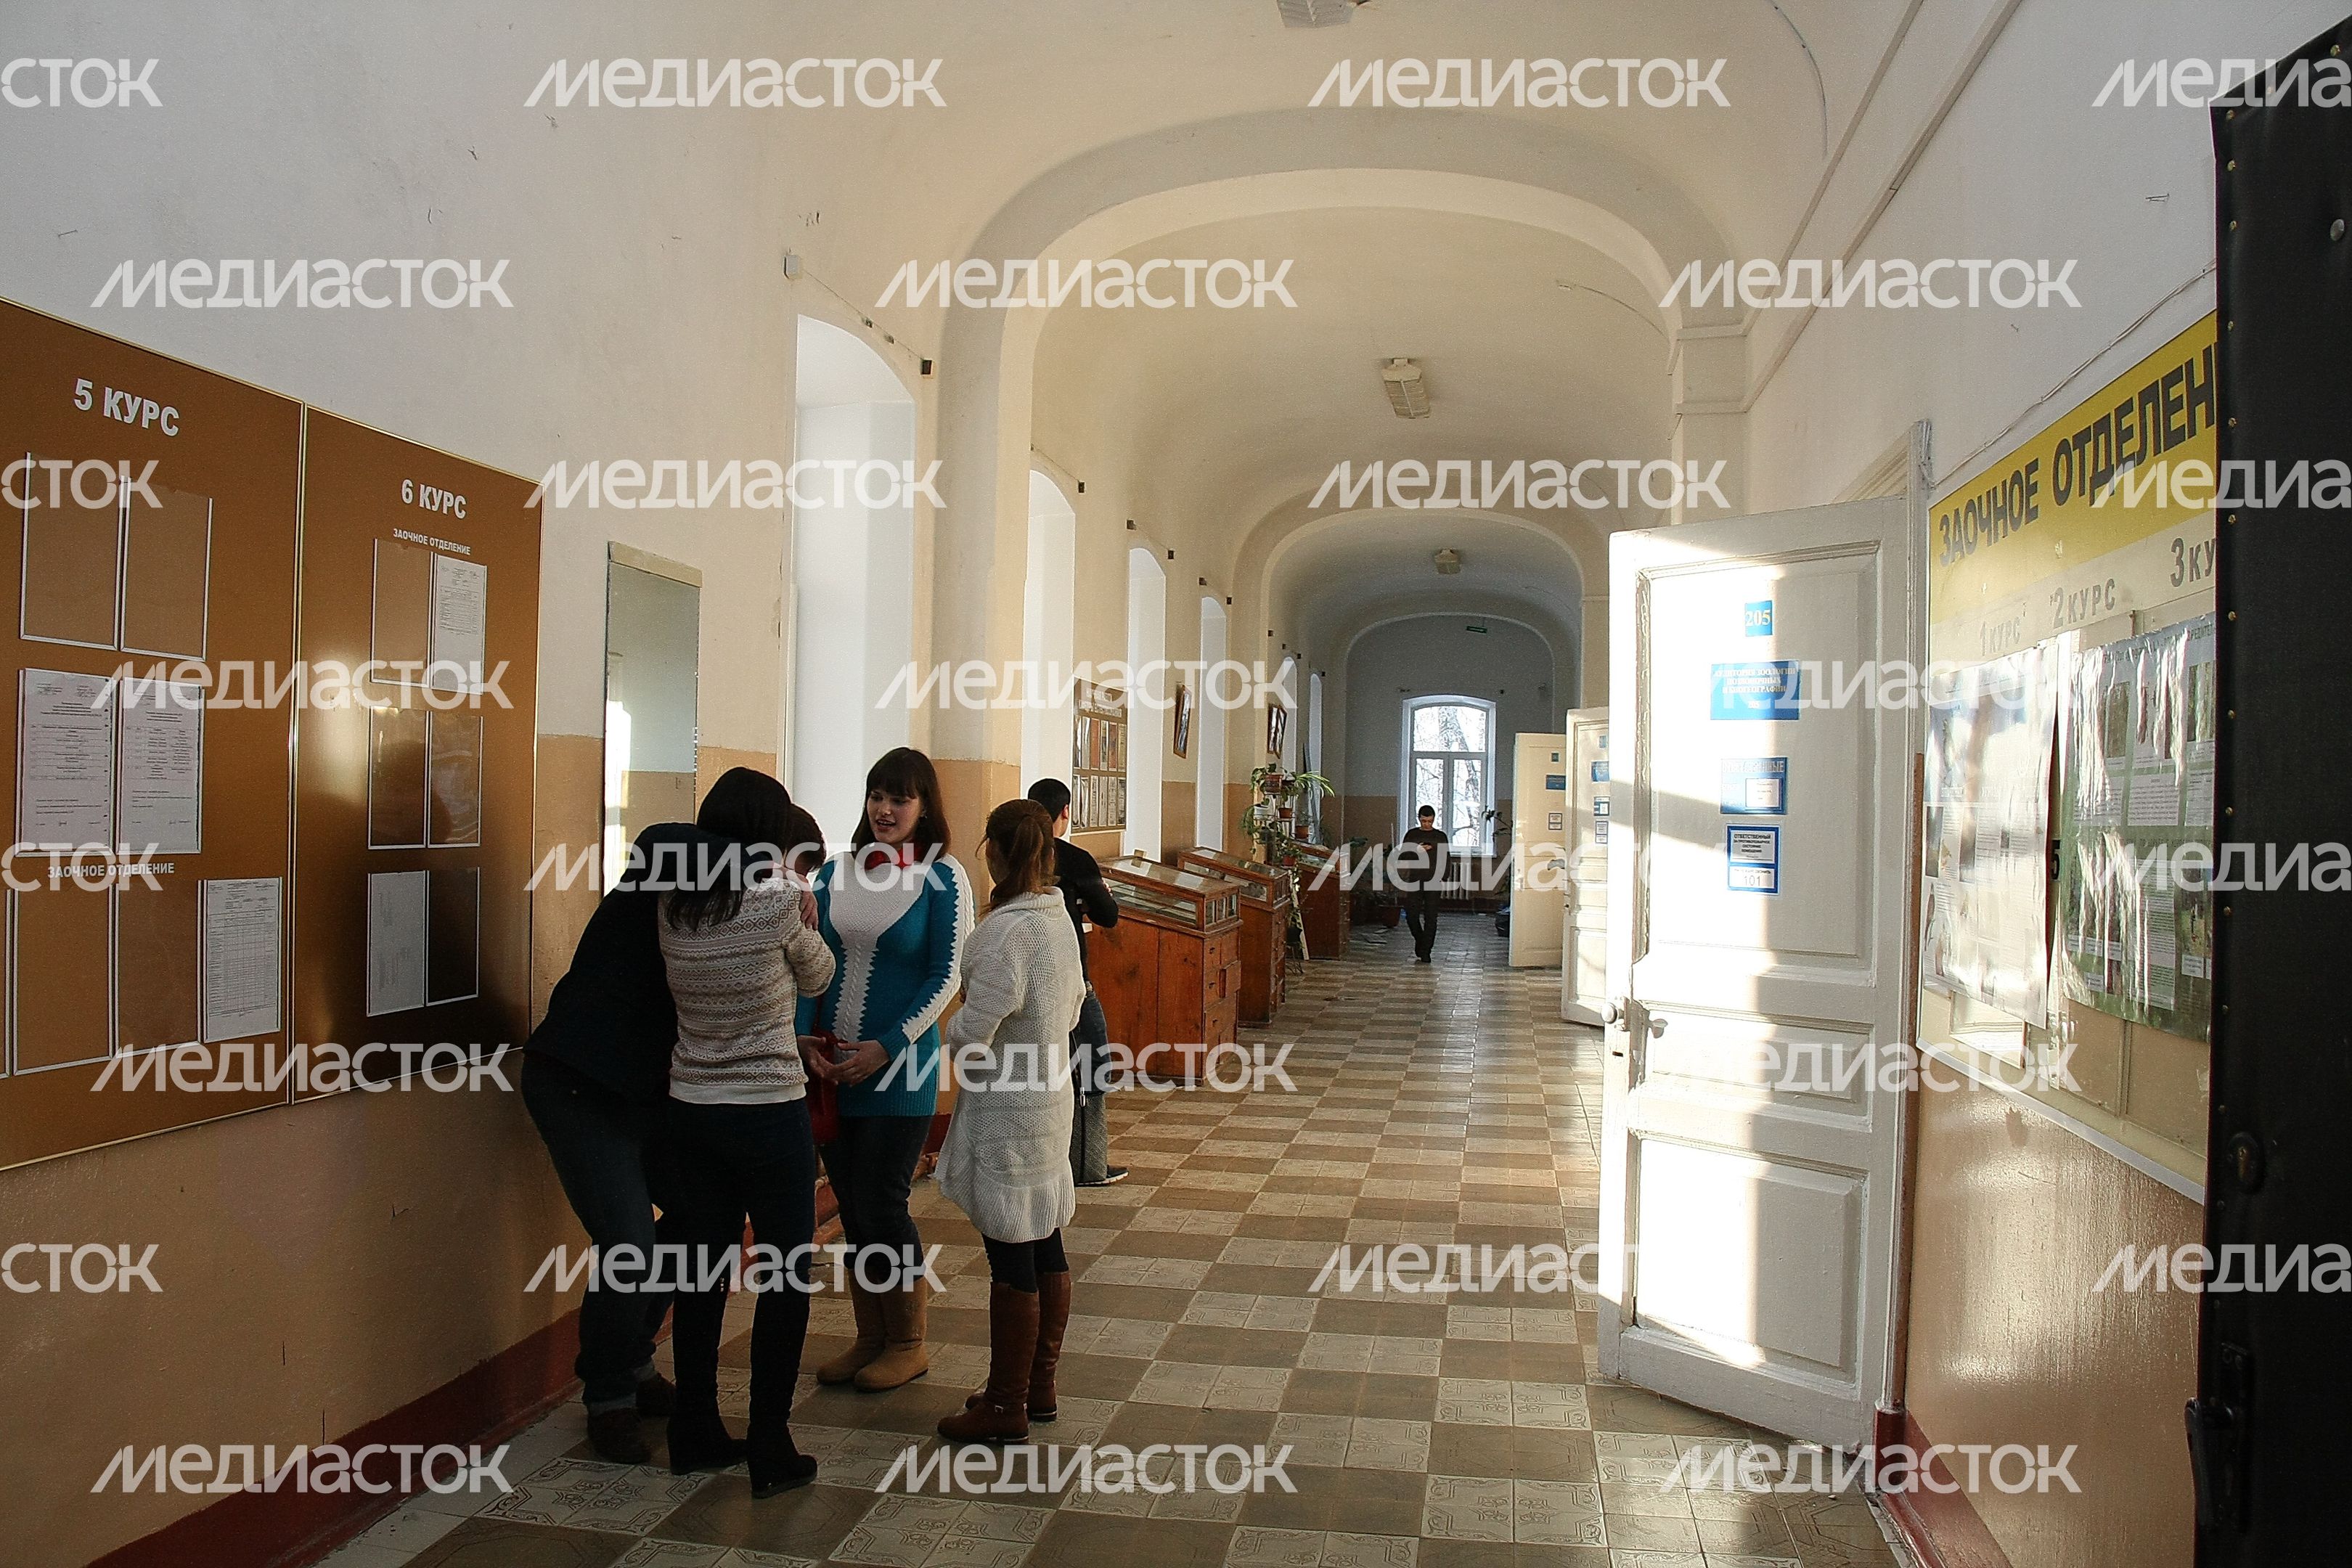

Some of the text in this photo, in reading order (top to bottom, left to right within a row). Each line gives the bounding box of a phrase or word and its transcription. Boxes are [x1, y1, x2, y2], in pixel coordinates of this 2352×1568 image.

[73, 377, 179, 437] 5 КУРС
[1939, 341, 2217, 568] ЗАОЧНОЕ ОТДЕЛЕН
[401, 479, 467, 519] 6 КУРС
[393, 528, 471, 556] ЗАОЧНОЕ ОТДЕЛЕНИЕ
[2170, 537, 2184, 587] 3
[1744, 610, 1771, 626] 205
[2052, 579, 2115, 629] 2 КУРС
[47, 862, 175, 878] ЗАОЧНОЕ ОТДЕЛЕНИЕ
[1744, 875, 1760, 886] 101
